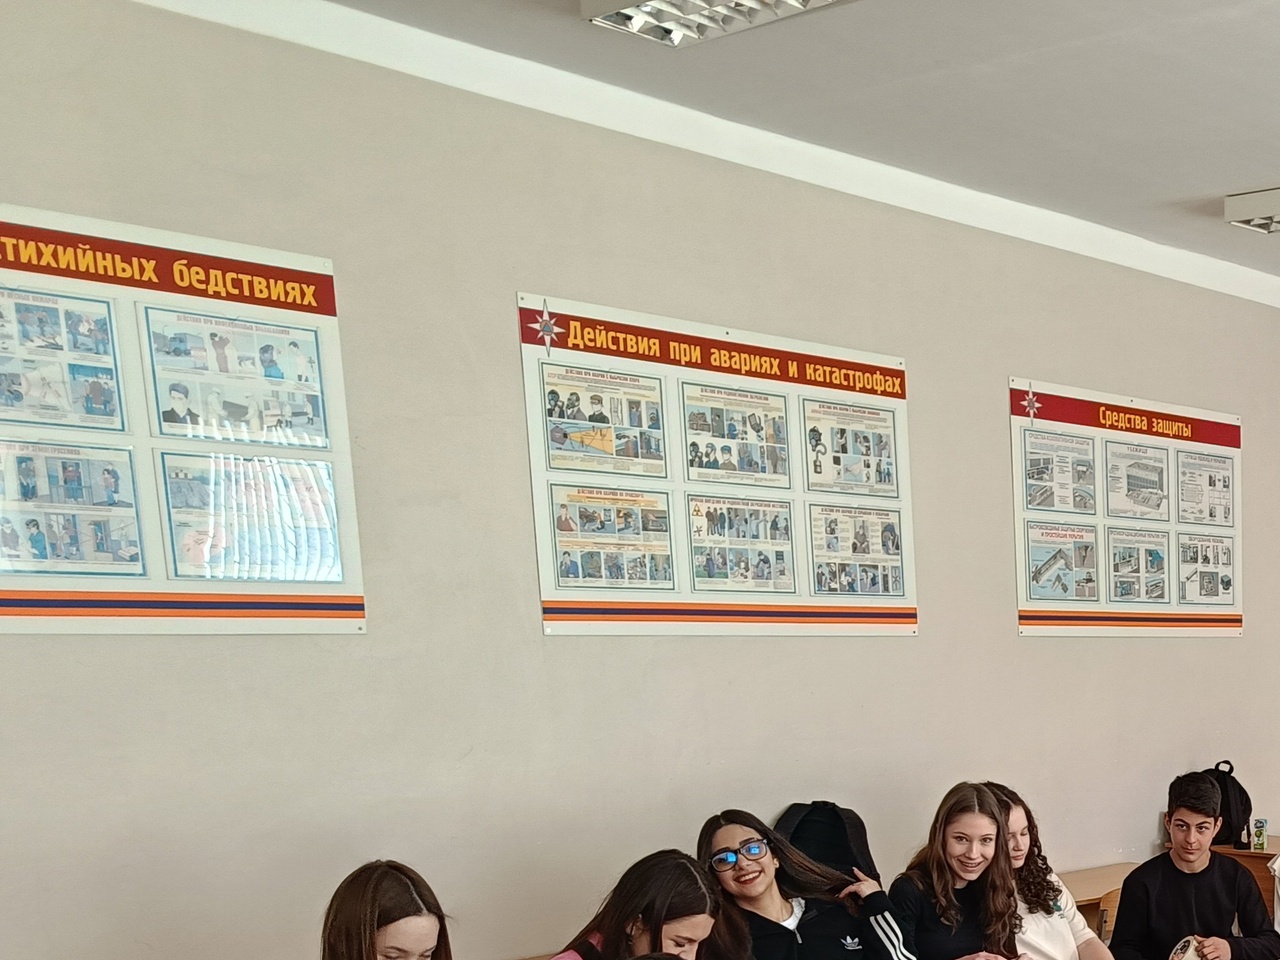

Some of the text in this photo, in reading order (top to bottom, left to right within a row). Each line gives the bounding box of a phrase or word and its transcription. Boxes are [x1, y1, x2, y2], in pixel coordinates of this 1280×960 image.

[172, 259, 318, 307] бедствиях
[567, 320, 902, 395] Действия при авариях и катастрофах
[1099, 406, 1192, 437] Средства защиты
